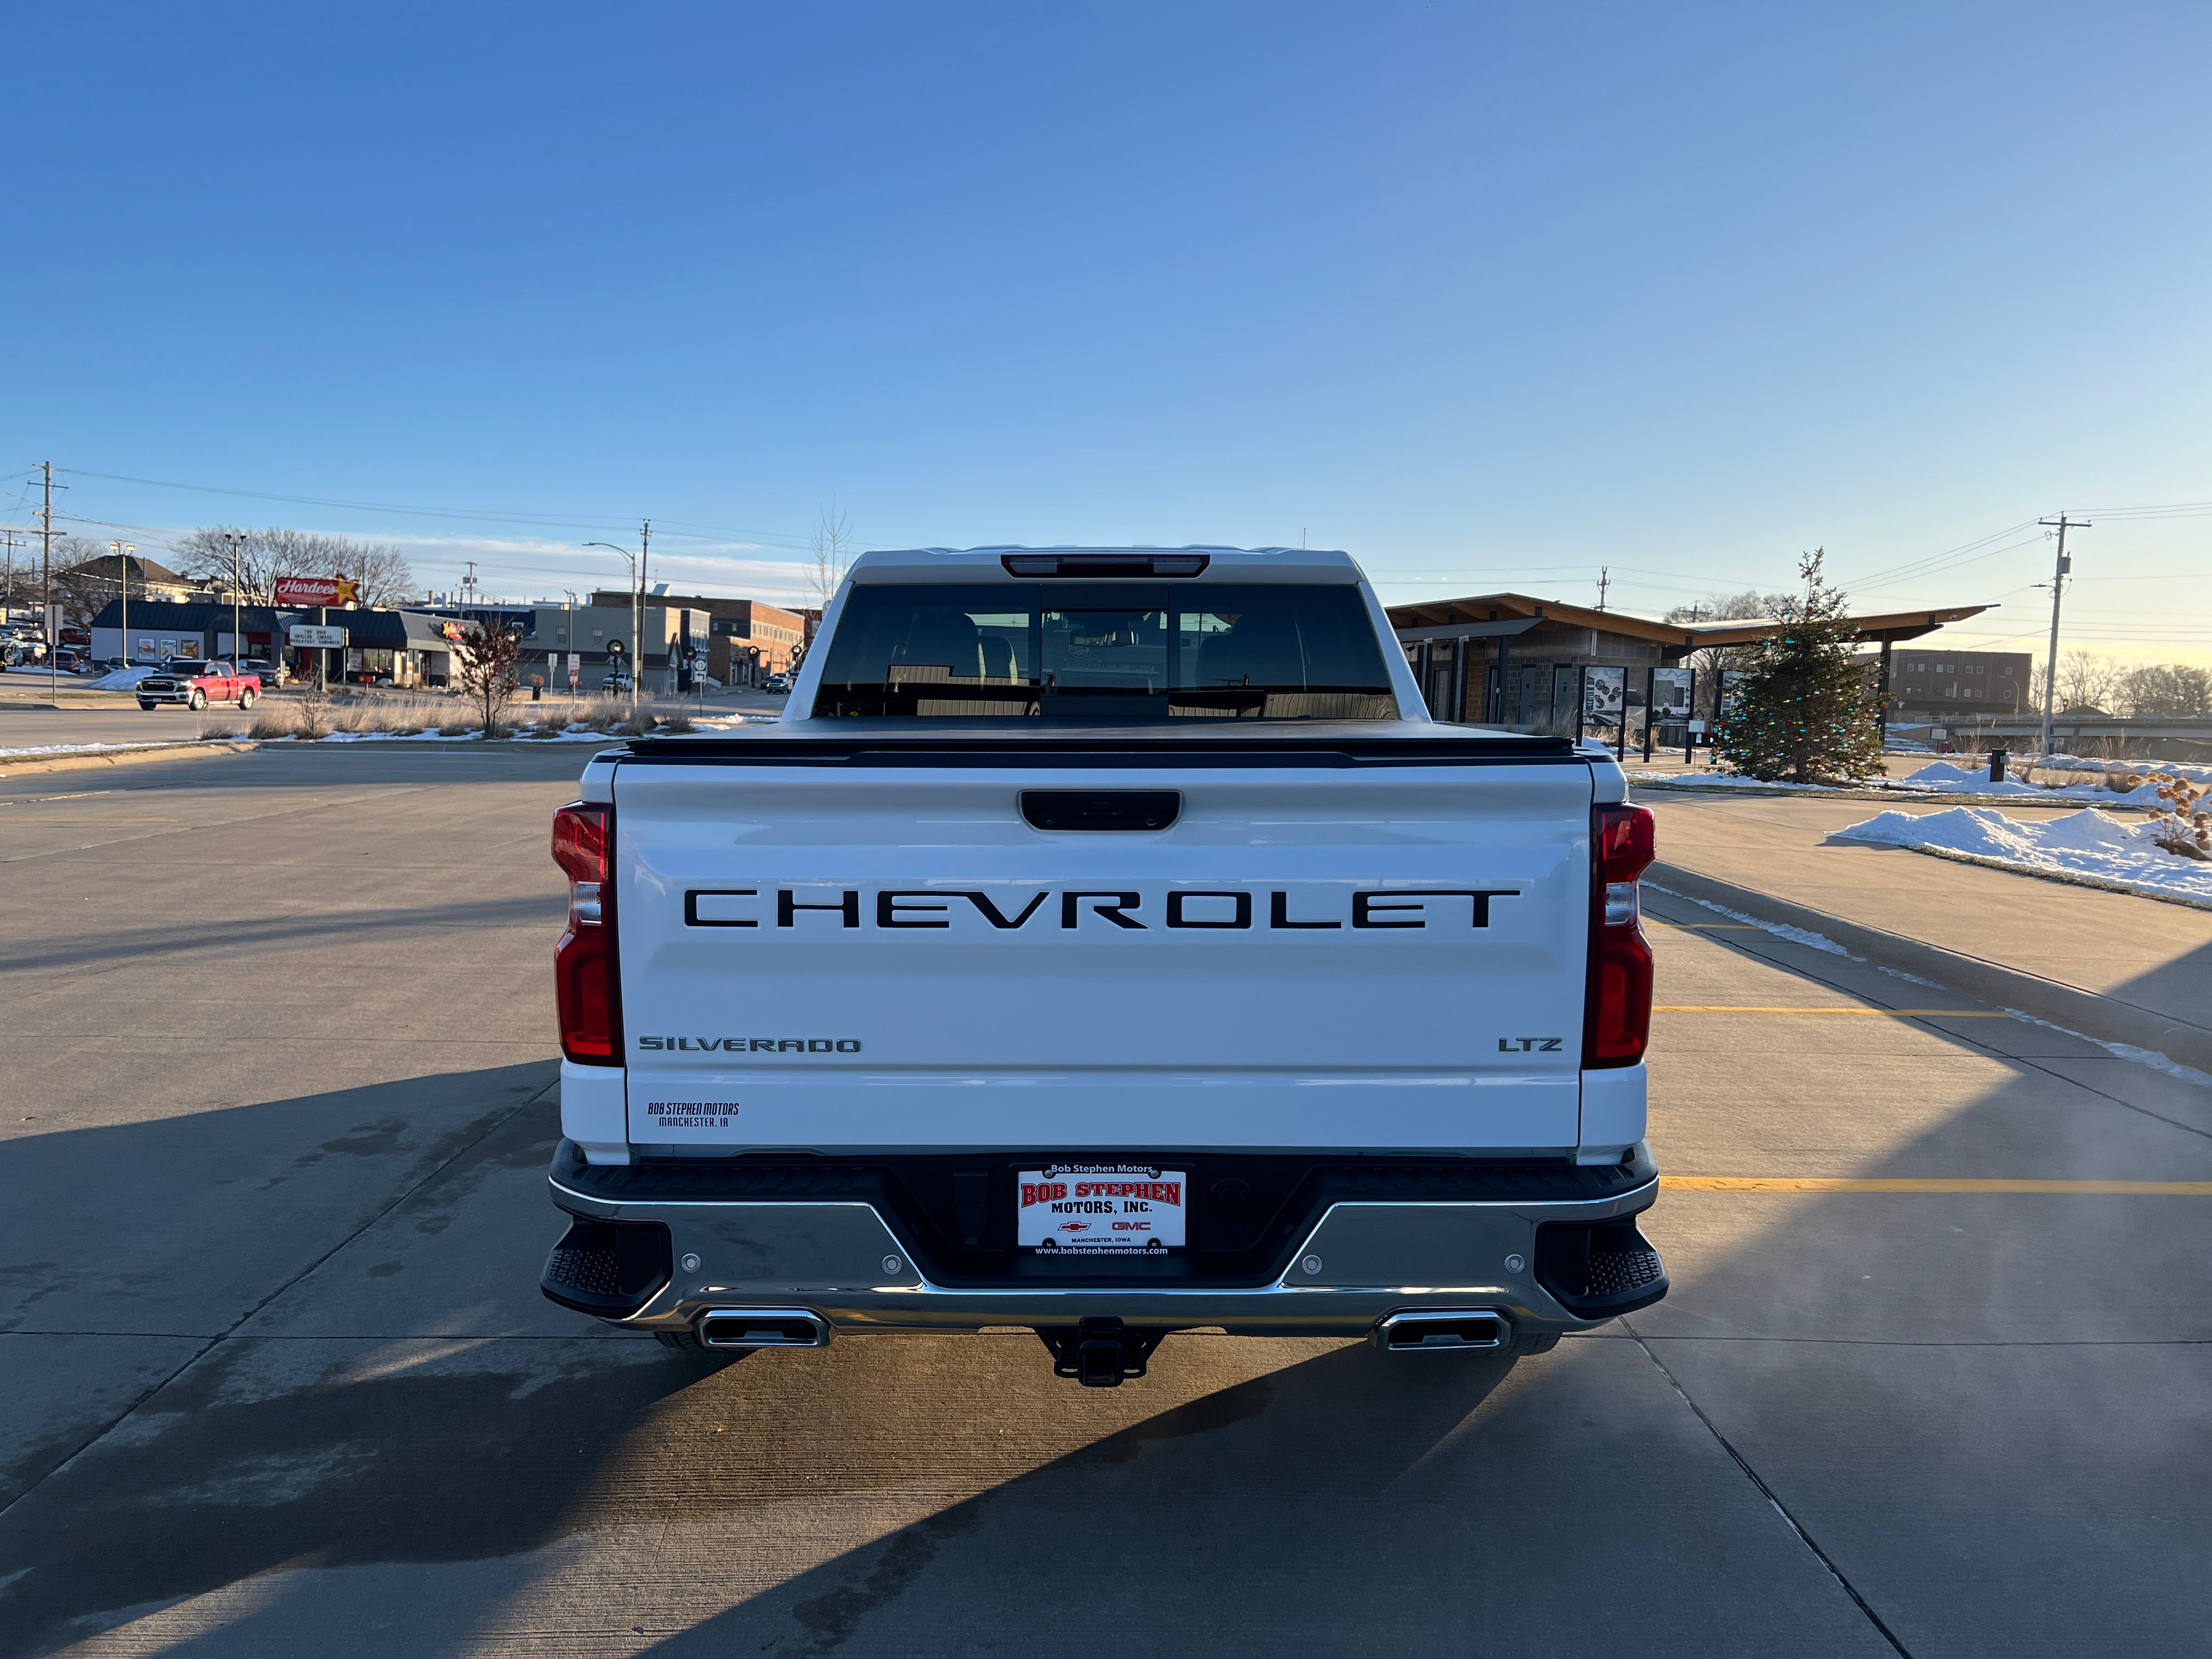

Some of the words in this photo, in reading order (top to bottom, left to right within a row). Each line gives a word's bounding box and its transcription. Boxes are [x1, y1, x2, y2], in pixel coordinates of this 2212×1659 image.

[277, 580, 336, 595] Hardee's
[684, 889, 1521, 930] CHEVROLET
[639, 1036, 861, 1053] SILVERADO
[1498, 1037, 1562, 1052] LTZ
[648, 1102, 665, 1115] BOB
[666, 1102, 702, 1115] STEPHEN
[703, 1103, 740, 1115] MOTORS
[720, 1118, 729, 1127] IA
[1051, 1165, 1071, 1173] Bob
[1074, 1164, 1114, 1173] Stephen
[1118, 1164, 1153, 1173] Motors
[1021, 1182, 1067, 1208] BOB
[1075, 1182, 1181, 1206] STEPHEN
[1051, 1201, 1118, 1215] MOTORS,
[1124, 1201, 1153, 1212] INC.
[1111, 1221, 1151, 1231] GMC
[1035, 1246, 1168, 1255] www.bobstephenmotors.com
